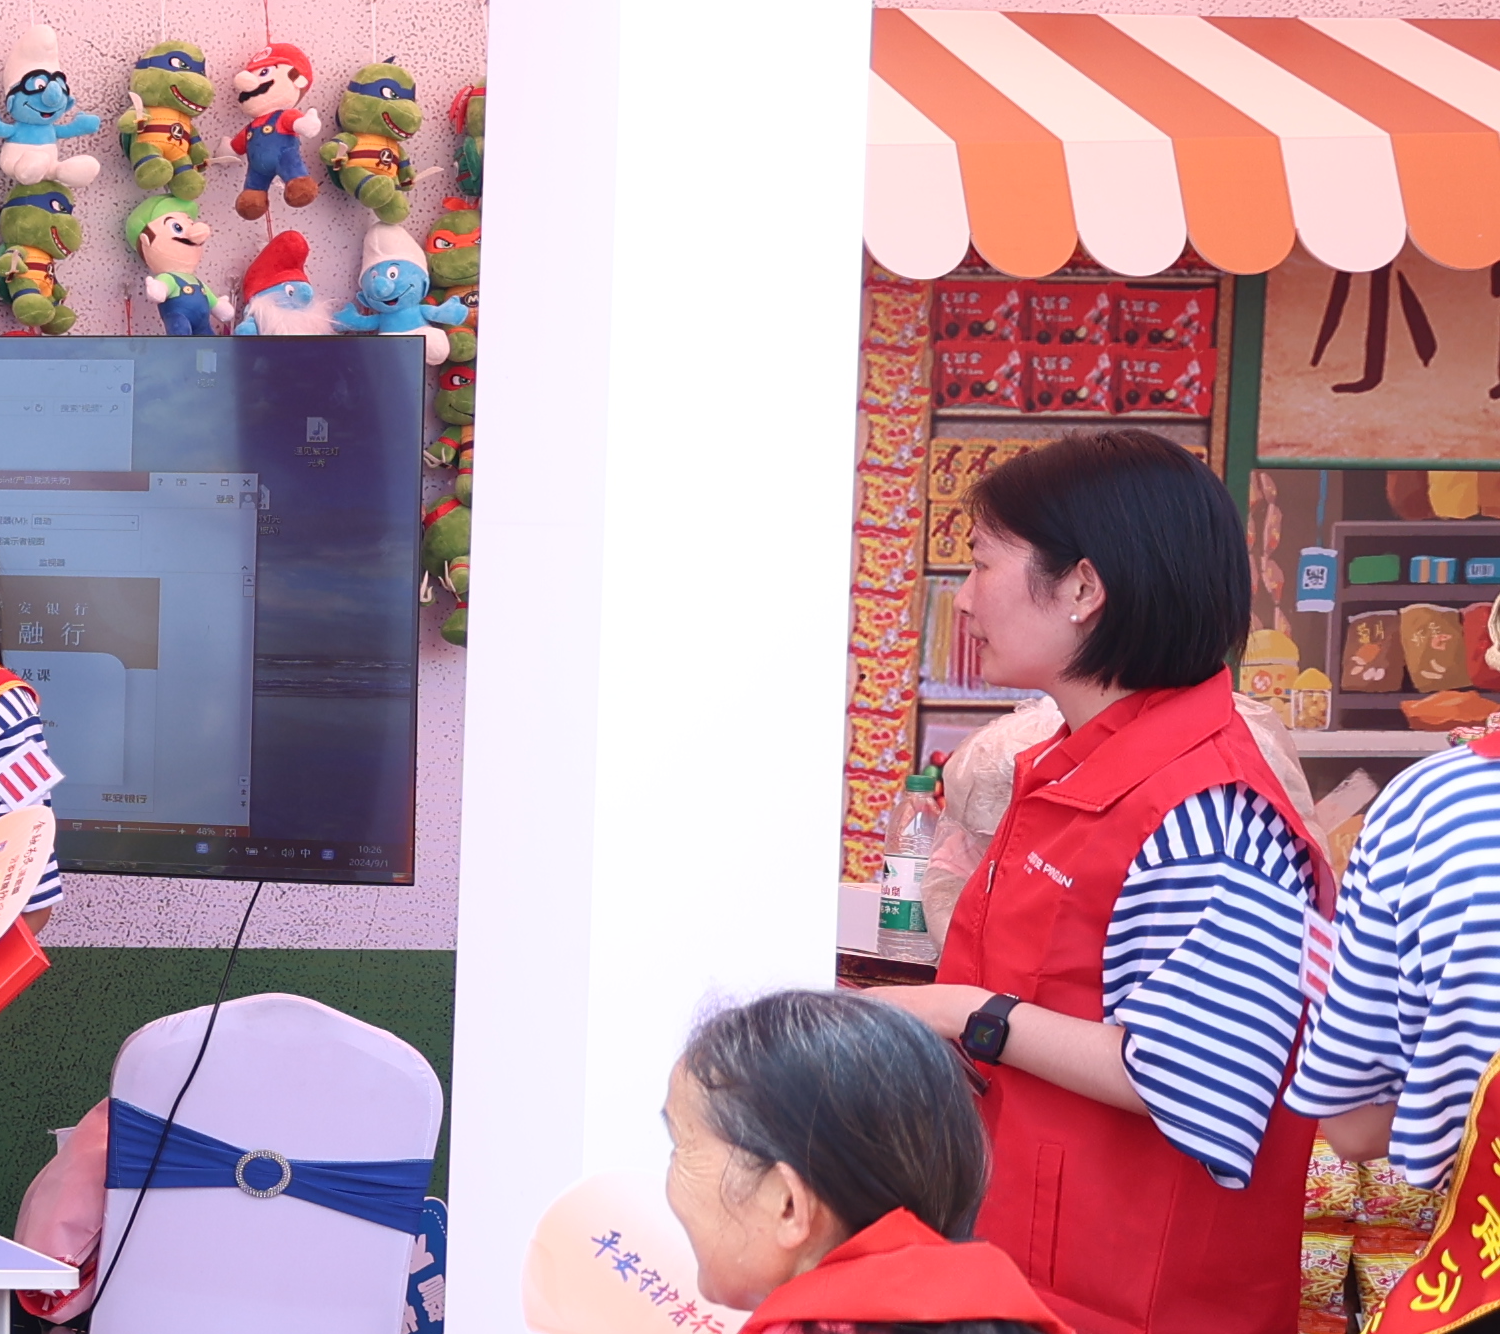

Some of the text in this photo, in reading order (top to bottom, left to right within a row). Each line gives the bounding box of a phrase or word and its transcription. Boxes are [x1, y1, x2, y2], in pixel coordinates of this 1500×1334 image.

[0, 601, 89, 616] 安银行
[101, 793, 148, 804] 平安银行
[358, 845, 382, 854] 10:26
[349, 858, 389, 868] 2024/9/1
